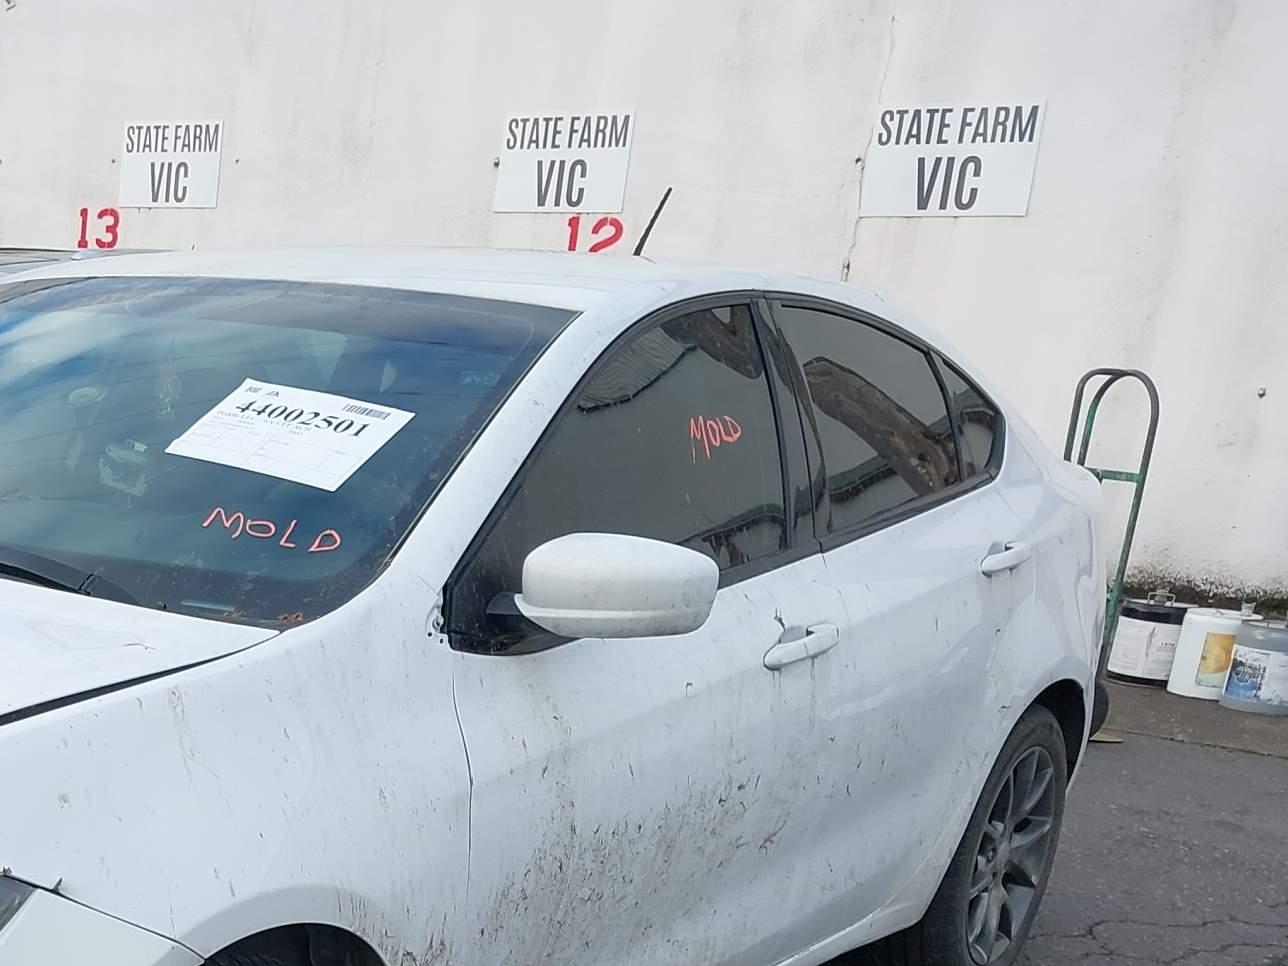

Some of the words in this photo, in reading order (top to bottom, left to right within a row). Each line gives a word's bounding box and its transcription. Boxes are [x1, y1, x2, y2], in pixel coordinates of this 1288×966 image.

[125, 124, 170, 154] STATE
[173, 123, 220, 153] FARM
[505, 116, 564, 151] STATE
[567, 115, 630, 150] FARM
[877, 107, 955, 146] STATE
[957, 105, 1040, 145] FARM
[150, 161, 189, 203] VIC
[536, 158, 588, 208] VIC
[915, 155, 983, 212] VIC
[77, 207, 121, 249] 13
[566, 215, 624, 253] 12
[235, 400, 372, 438] 44002501
[690, 415, 742, 459] MOLD
[202, 506, 342, 552] MOLD
